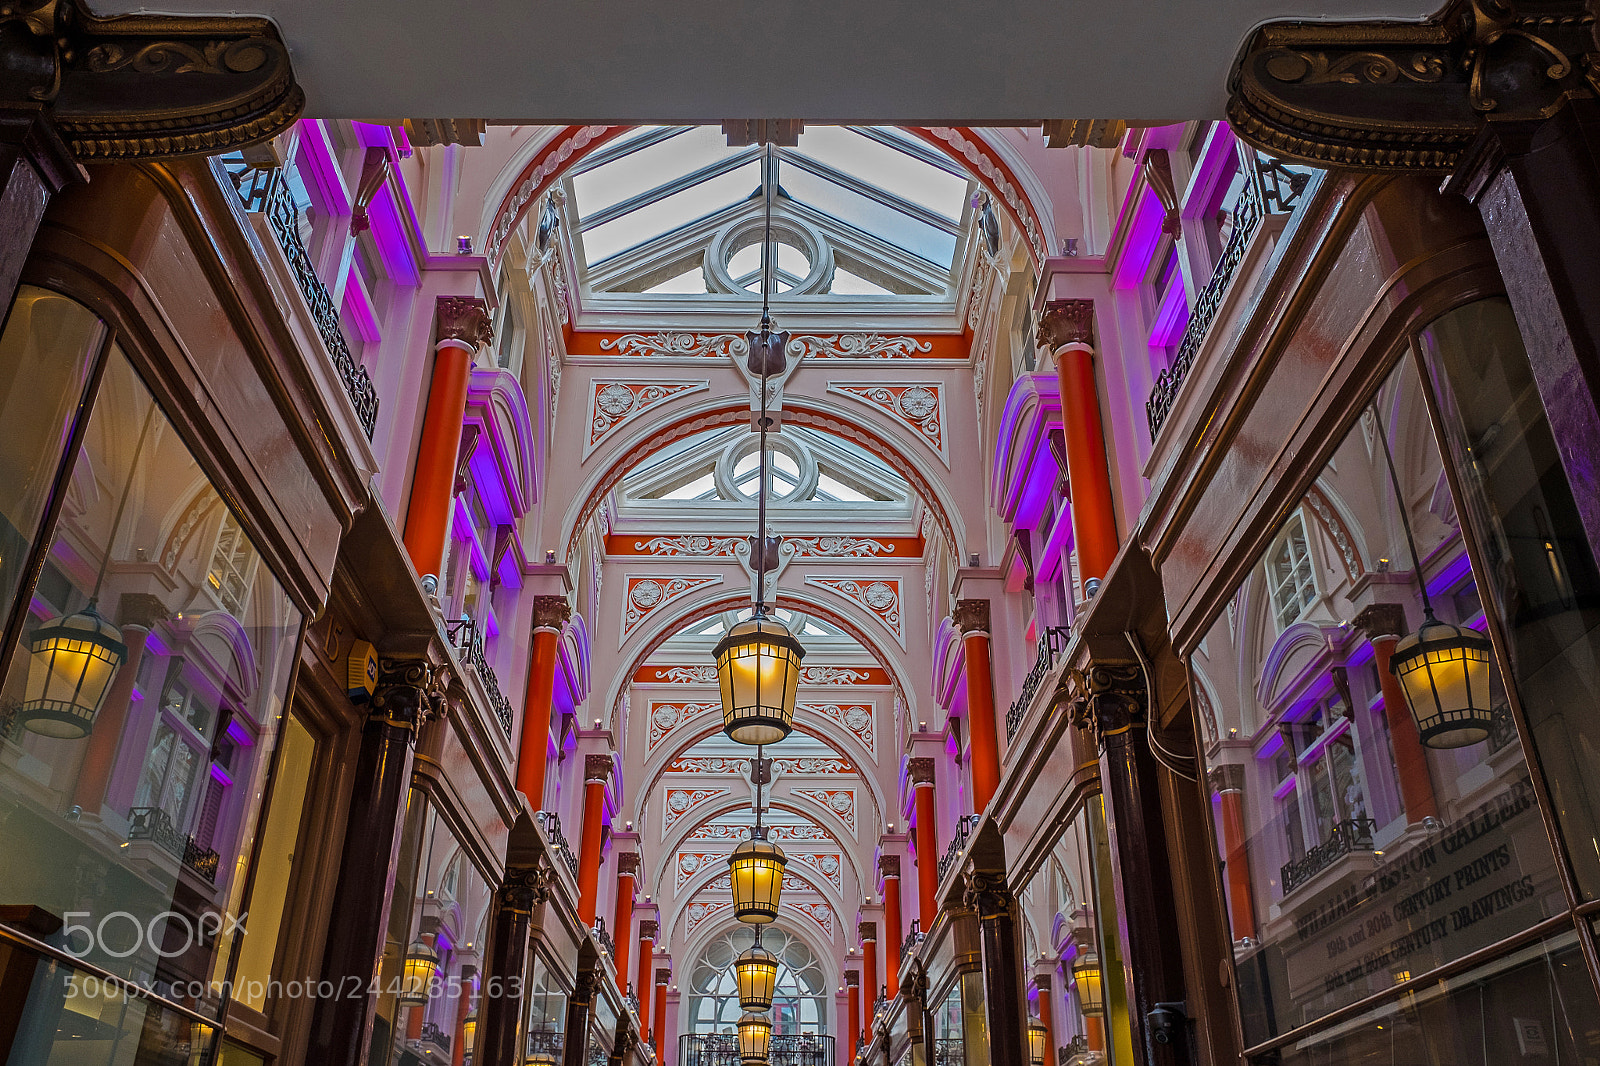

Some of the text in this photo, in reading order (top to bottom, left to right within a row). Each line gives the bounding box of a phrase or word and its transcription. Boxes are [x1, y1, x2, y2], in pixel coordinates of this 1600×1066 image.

[323, 613, 344, 661] 15
[1294, 884, 1359, 941] WILLIAM
[1361, 836, 1437, 899] WESTON
[1347, 923, 1366, 948] and
[1366, 911, 1393, 937] 20th
[1393, 875, 1452, 922] CENTURY
[1454, 844, 1510, 891] PRINTS
[1450, 874, 1535, 932] DRAWINGS
